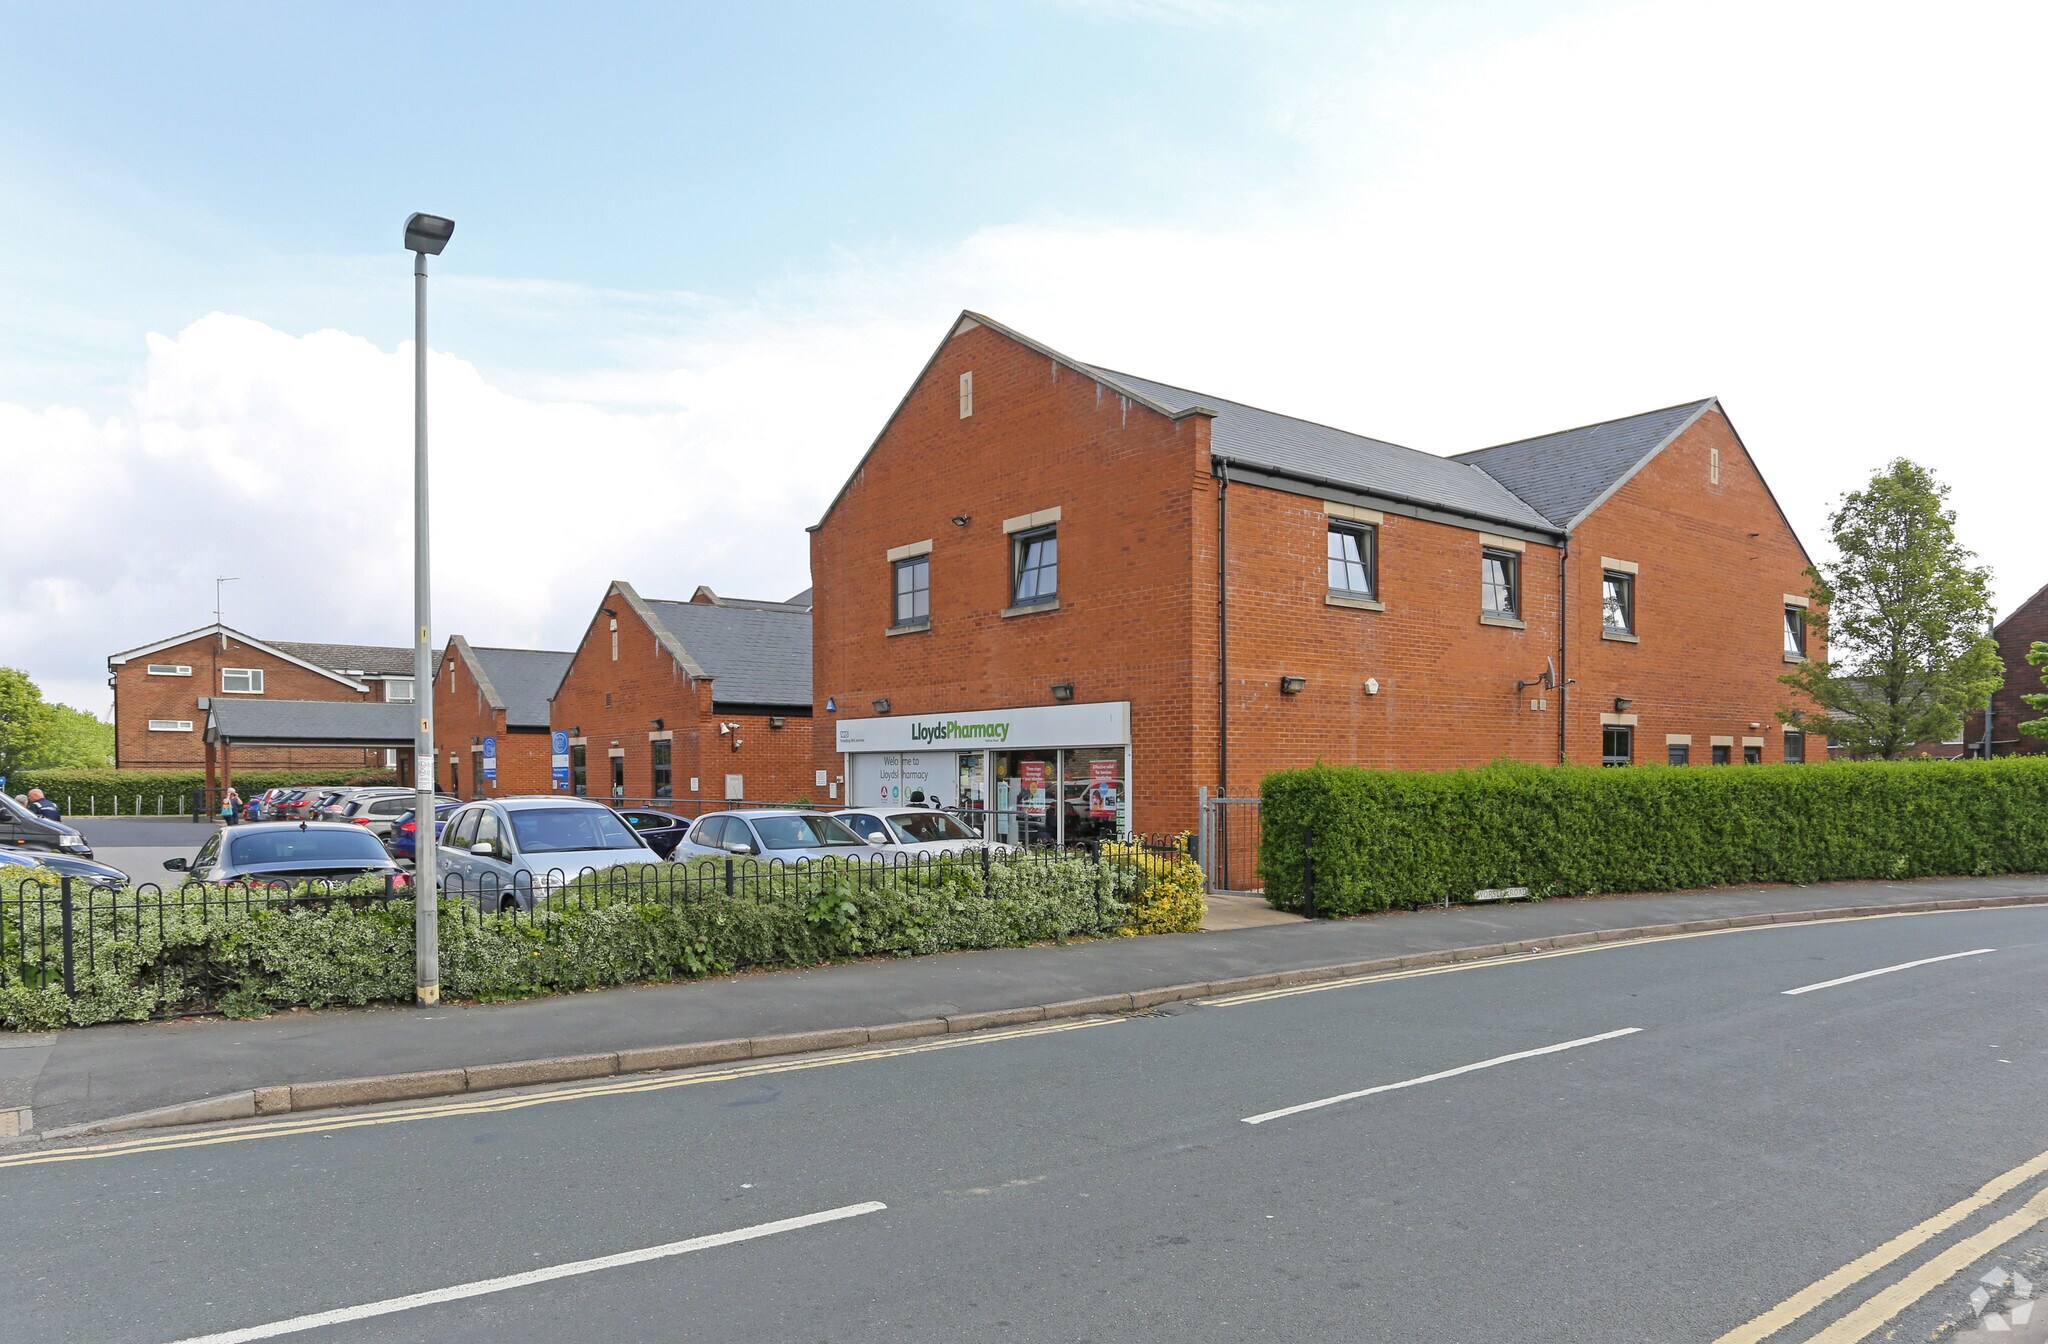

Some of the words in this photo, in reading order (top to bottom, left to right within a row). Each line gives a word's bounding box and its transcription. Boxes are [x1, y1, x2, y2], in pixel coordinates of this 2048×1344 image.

[912, 720, 1009, 744] LloydsPharmacy
[883, 756, 911, 766] Welcme
[913, 757, 919, 766] to
[1509, 887, 1527, 897] ROAD
